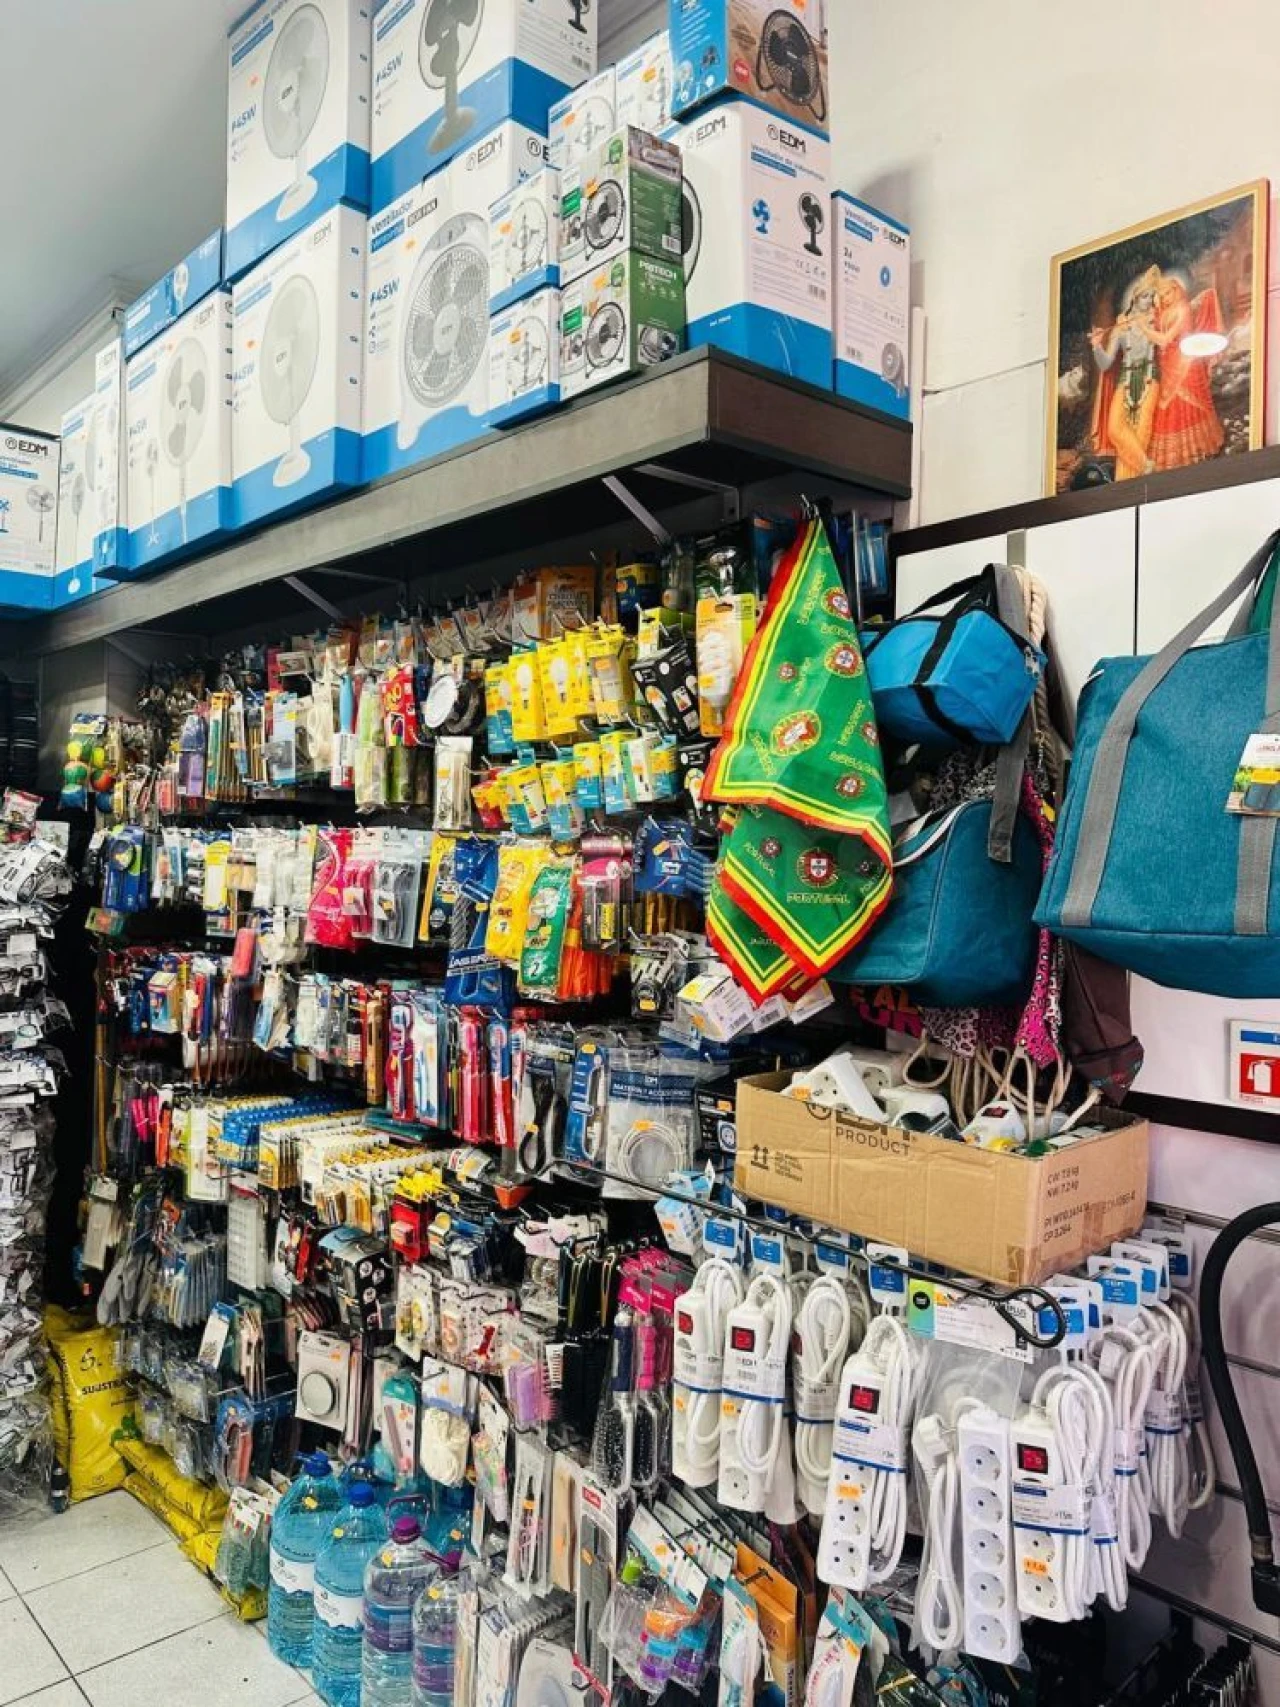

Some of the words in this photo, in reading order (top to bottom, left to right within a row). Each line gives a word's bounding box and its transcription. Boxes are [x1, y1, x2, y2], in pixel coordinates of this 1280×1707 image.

[696, 116, 725, 142] EDM
[780, 129, 806, 153] EDM
[477, 133, 502, 162] EDM
[19, 440, 48, 456] EDM
[836, 1126, 910, 1156] PRODUCT
